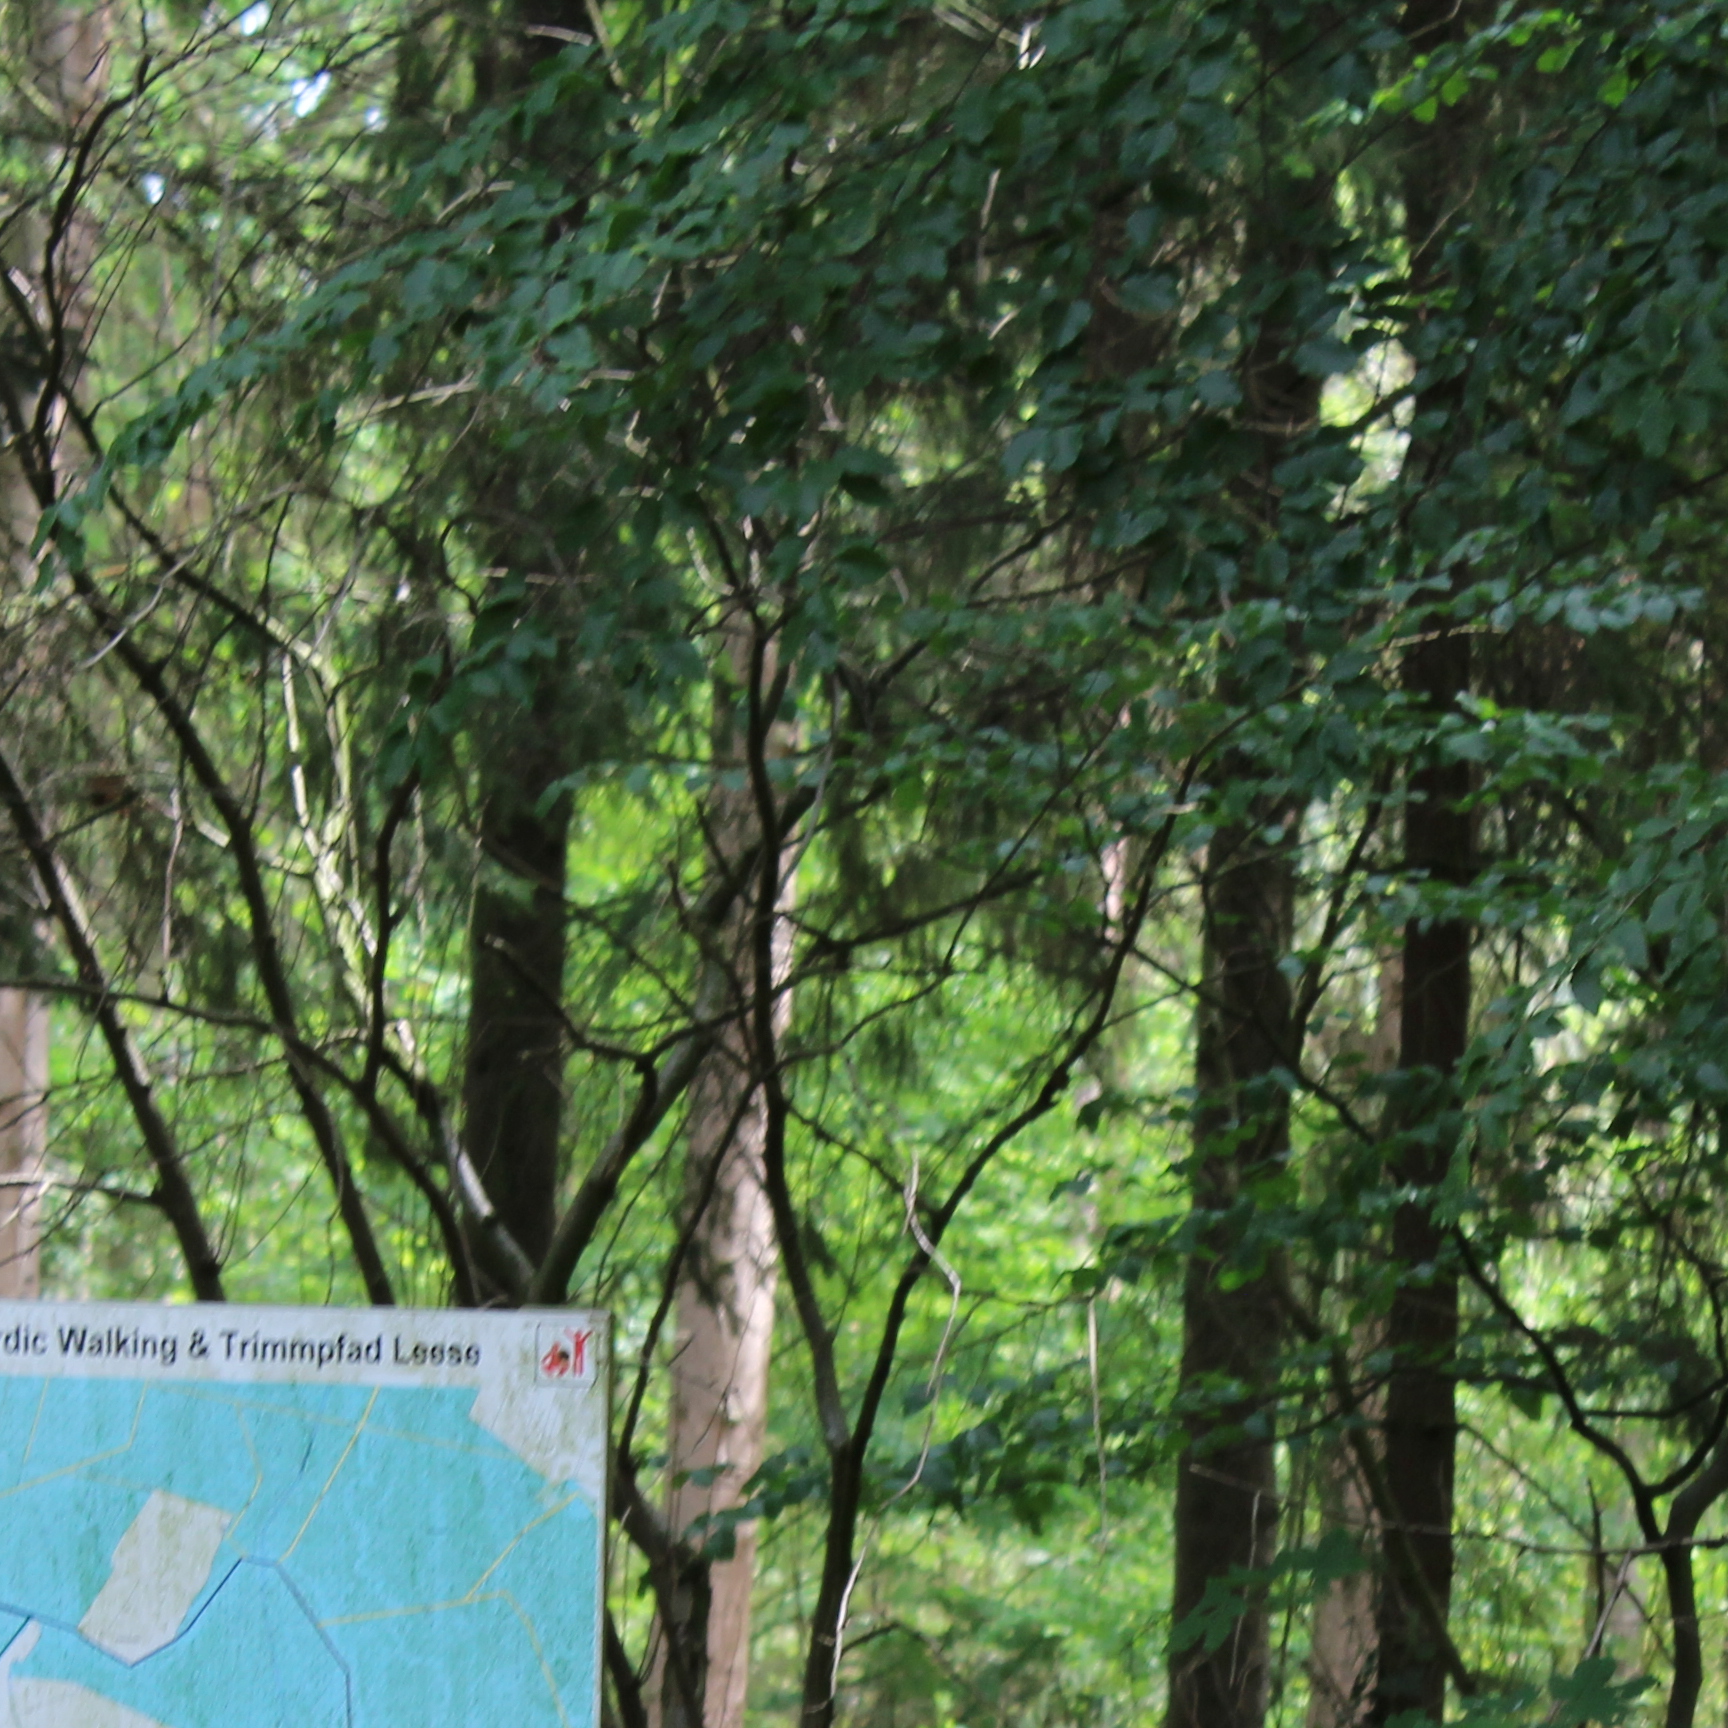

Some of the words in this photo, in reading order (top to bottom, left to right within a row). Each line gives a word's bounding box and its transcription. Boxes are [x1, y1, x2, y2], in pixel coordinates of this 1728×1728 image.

[57, 1325, 178, 1367] Walking
[188, 1329, 210, 1360] &
[220, 1330, 382, 1370] Trimmpfad
[393, 1334, 481, 1367] Leese
